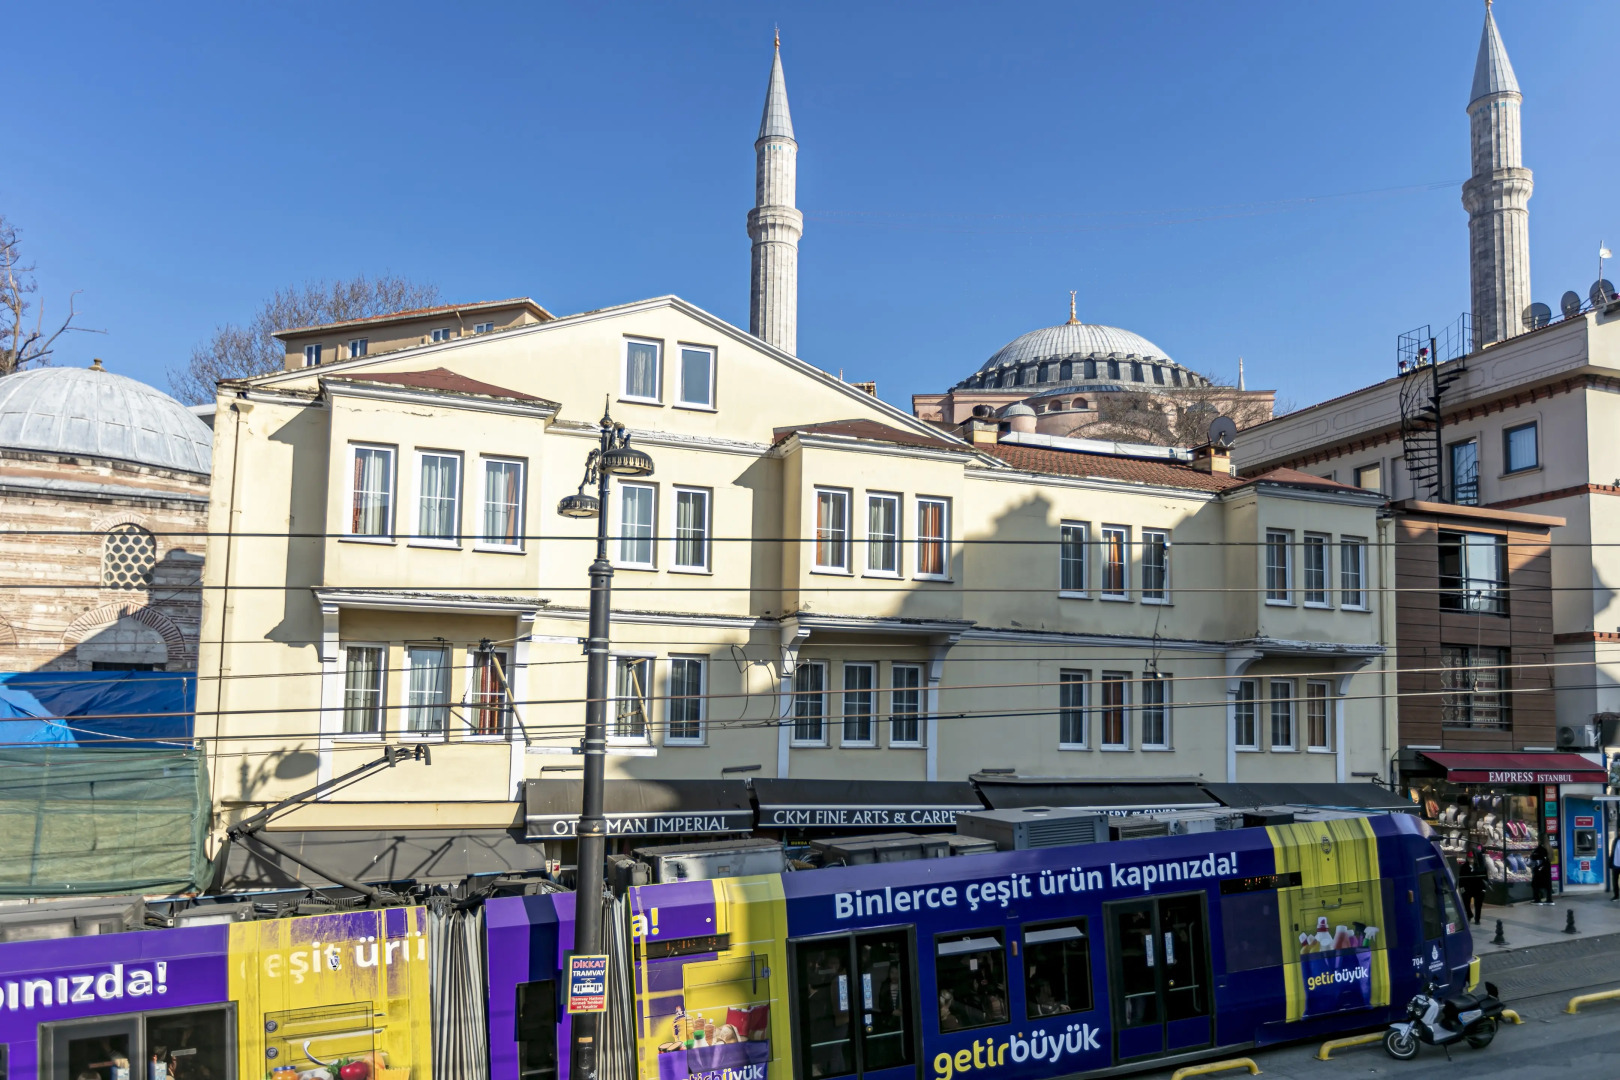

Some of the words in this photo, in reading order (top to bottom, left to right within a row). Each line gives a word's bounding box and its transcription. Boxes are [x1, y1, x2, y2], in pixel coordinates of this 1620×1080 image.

[1488, 771, 1534, 782] EMPRESS
[1537, 774, 1573, 782] ISTANBUL
[773, 810, 810, 824] CKM
[815, 810, 848, 824] FINE
[852, 810, 889, 824] ARTS
[893, 812, 907, 824] &
[911, 810, 972, 824] CARPE
[552, 818, 647, 836] OTMAN
[654, 816, 729, 832] IMPERIAL
[834, 886, 958, 919] Binlerce
[965, 873, 1032, 911] çeşit
[1039, 866, 1103, 896] ürün
[1110, 851, 1239, 891] kapınızda!
[573, 960, 605, 969] DİKKAT
[1412, 957, 1423, 967] 704
[1307, 966, 1369, 991] getirbüyük
[933, 1023, 1101, 1080] getirbüyük
